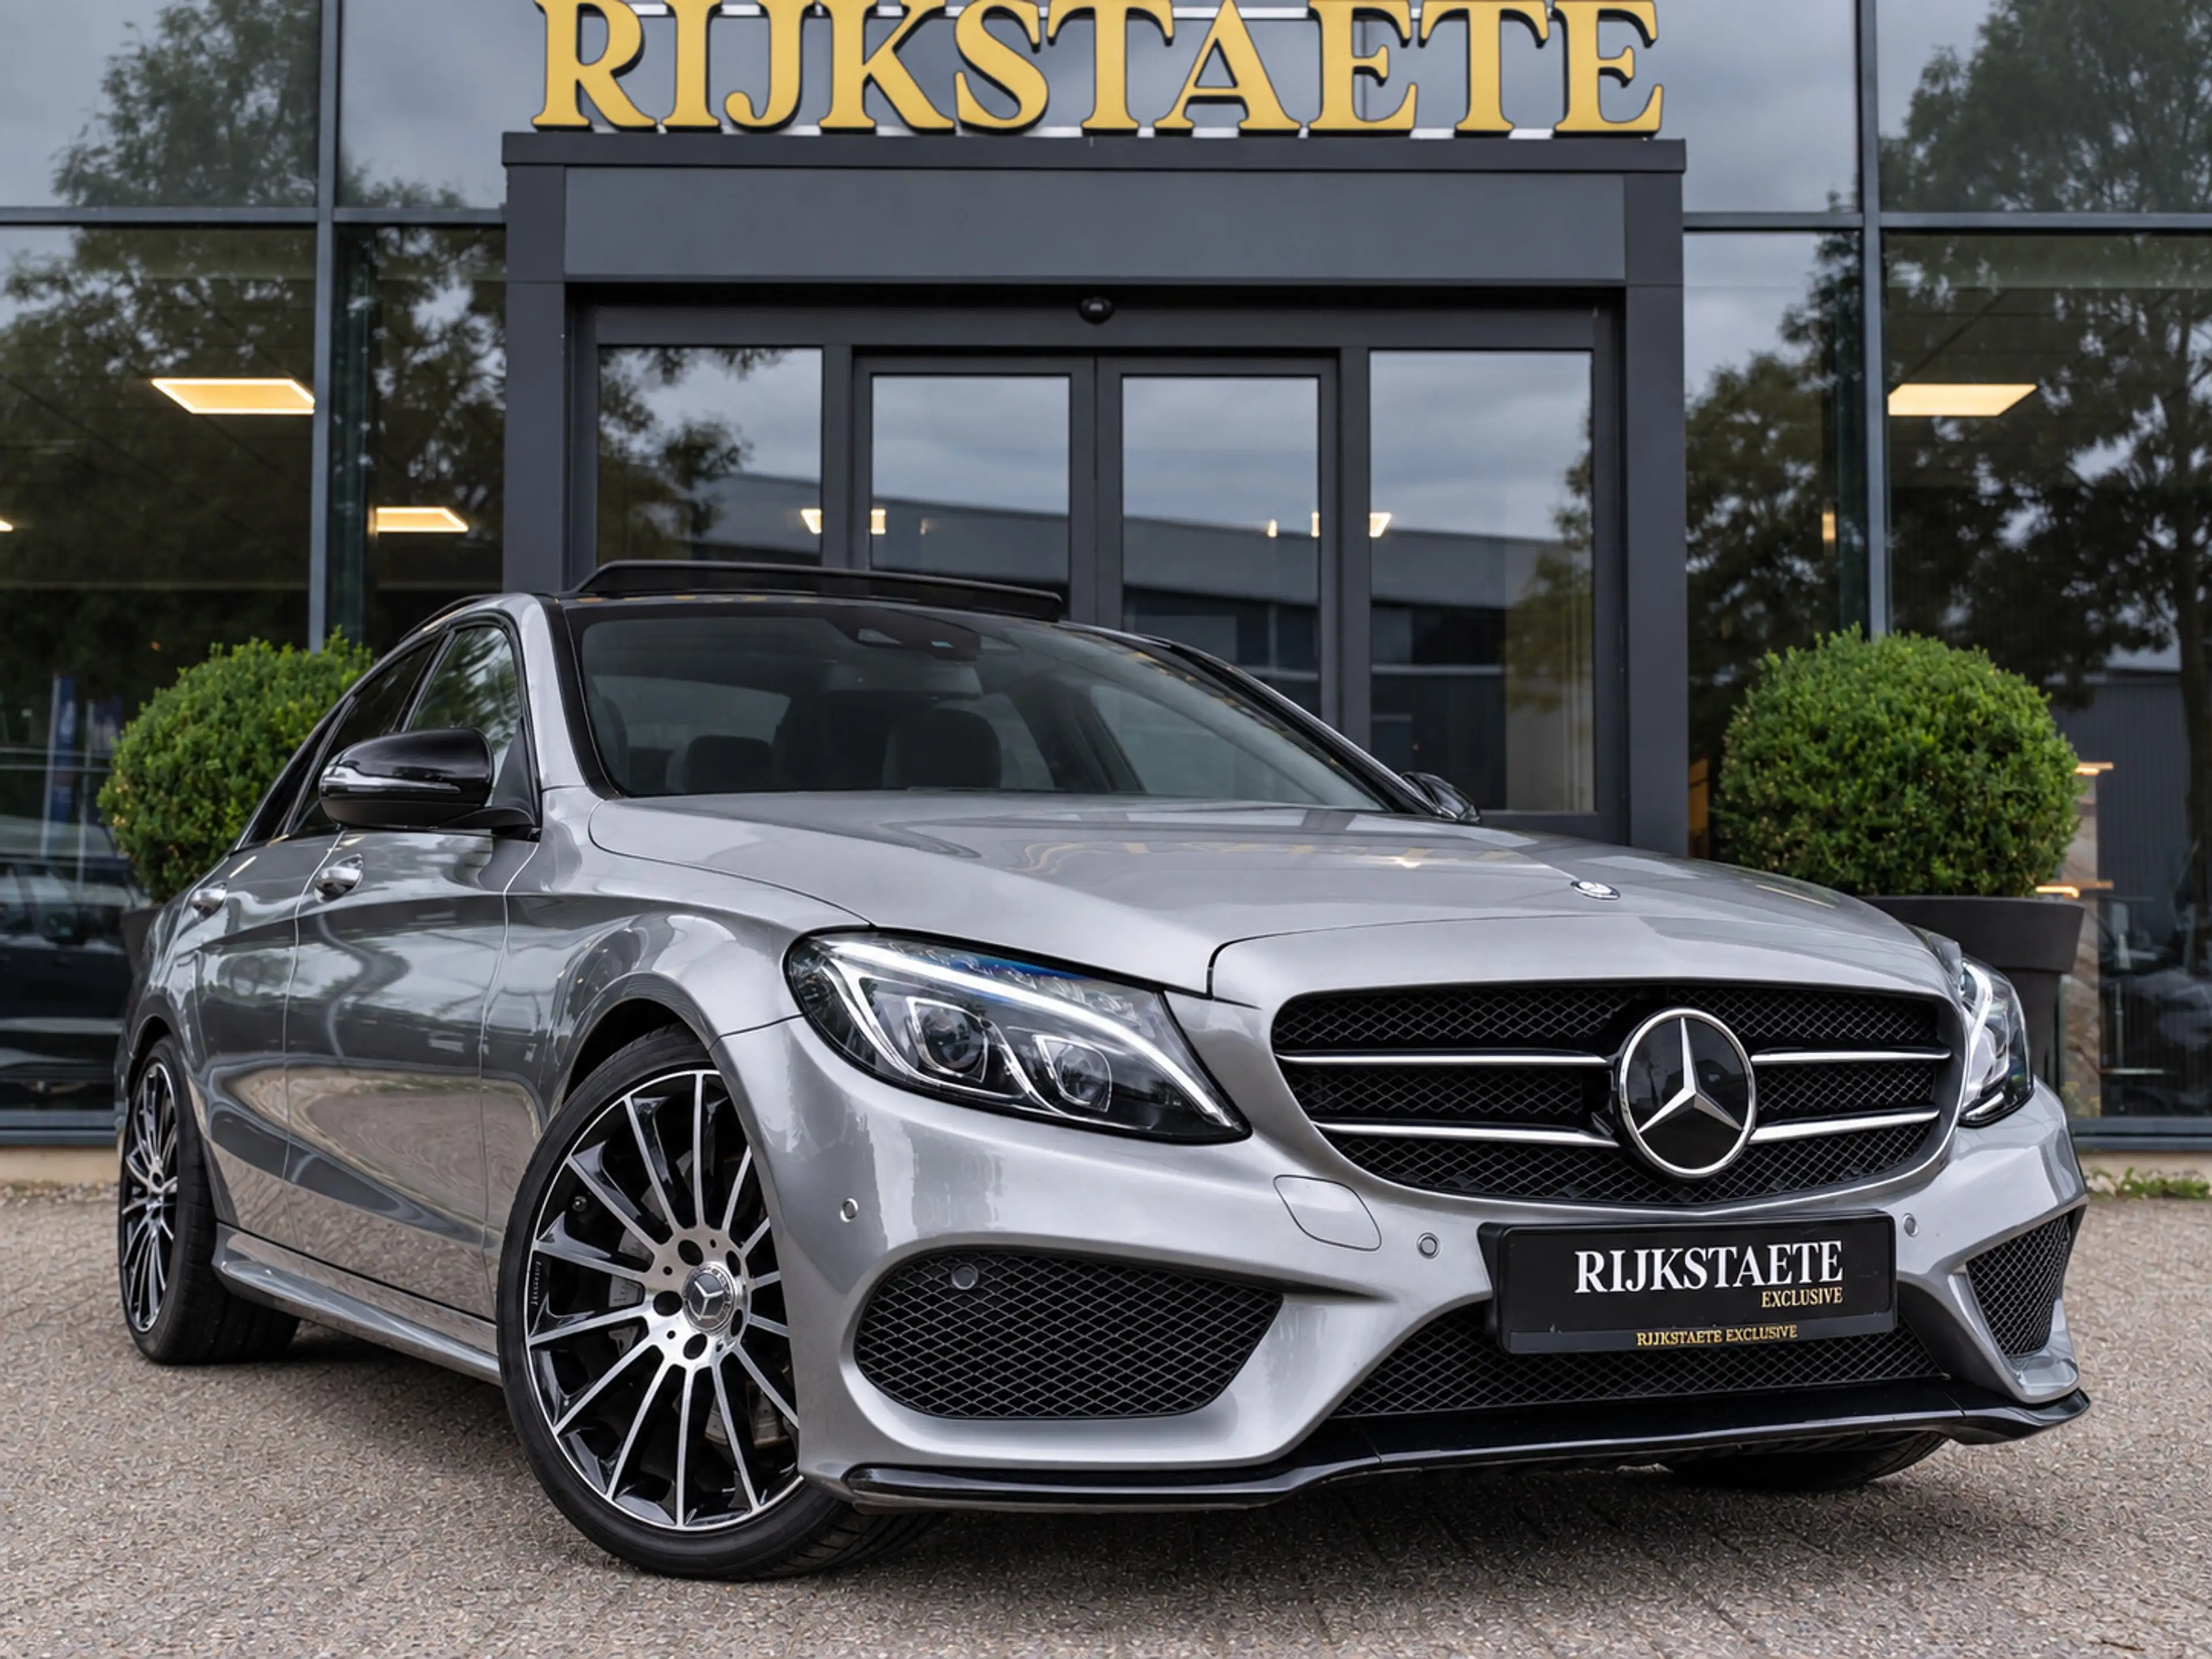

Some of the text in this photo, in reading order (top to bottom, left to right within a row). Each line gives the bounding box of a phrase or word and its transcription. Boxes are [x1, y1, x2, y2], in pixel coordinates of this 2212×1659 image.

[531, 0, 1664, 134] RIJKSTAETE
[1574, 1240, 1843, 1293] RIJKSTAETE
[1762, 1286, 1843, 1308] EXCLUSIVE
[1636, 1324, 1797, 1346] RIJKSTAETE EXCLUSIVE
